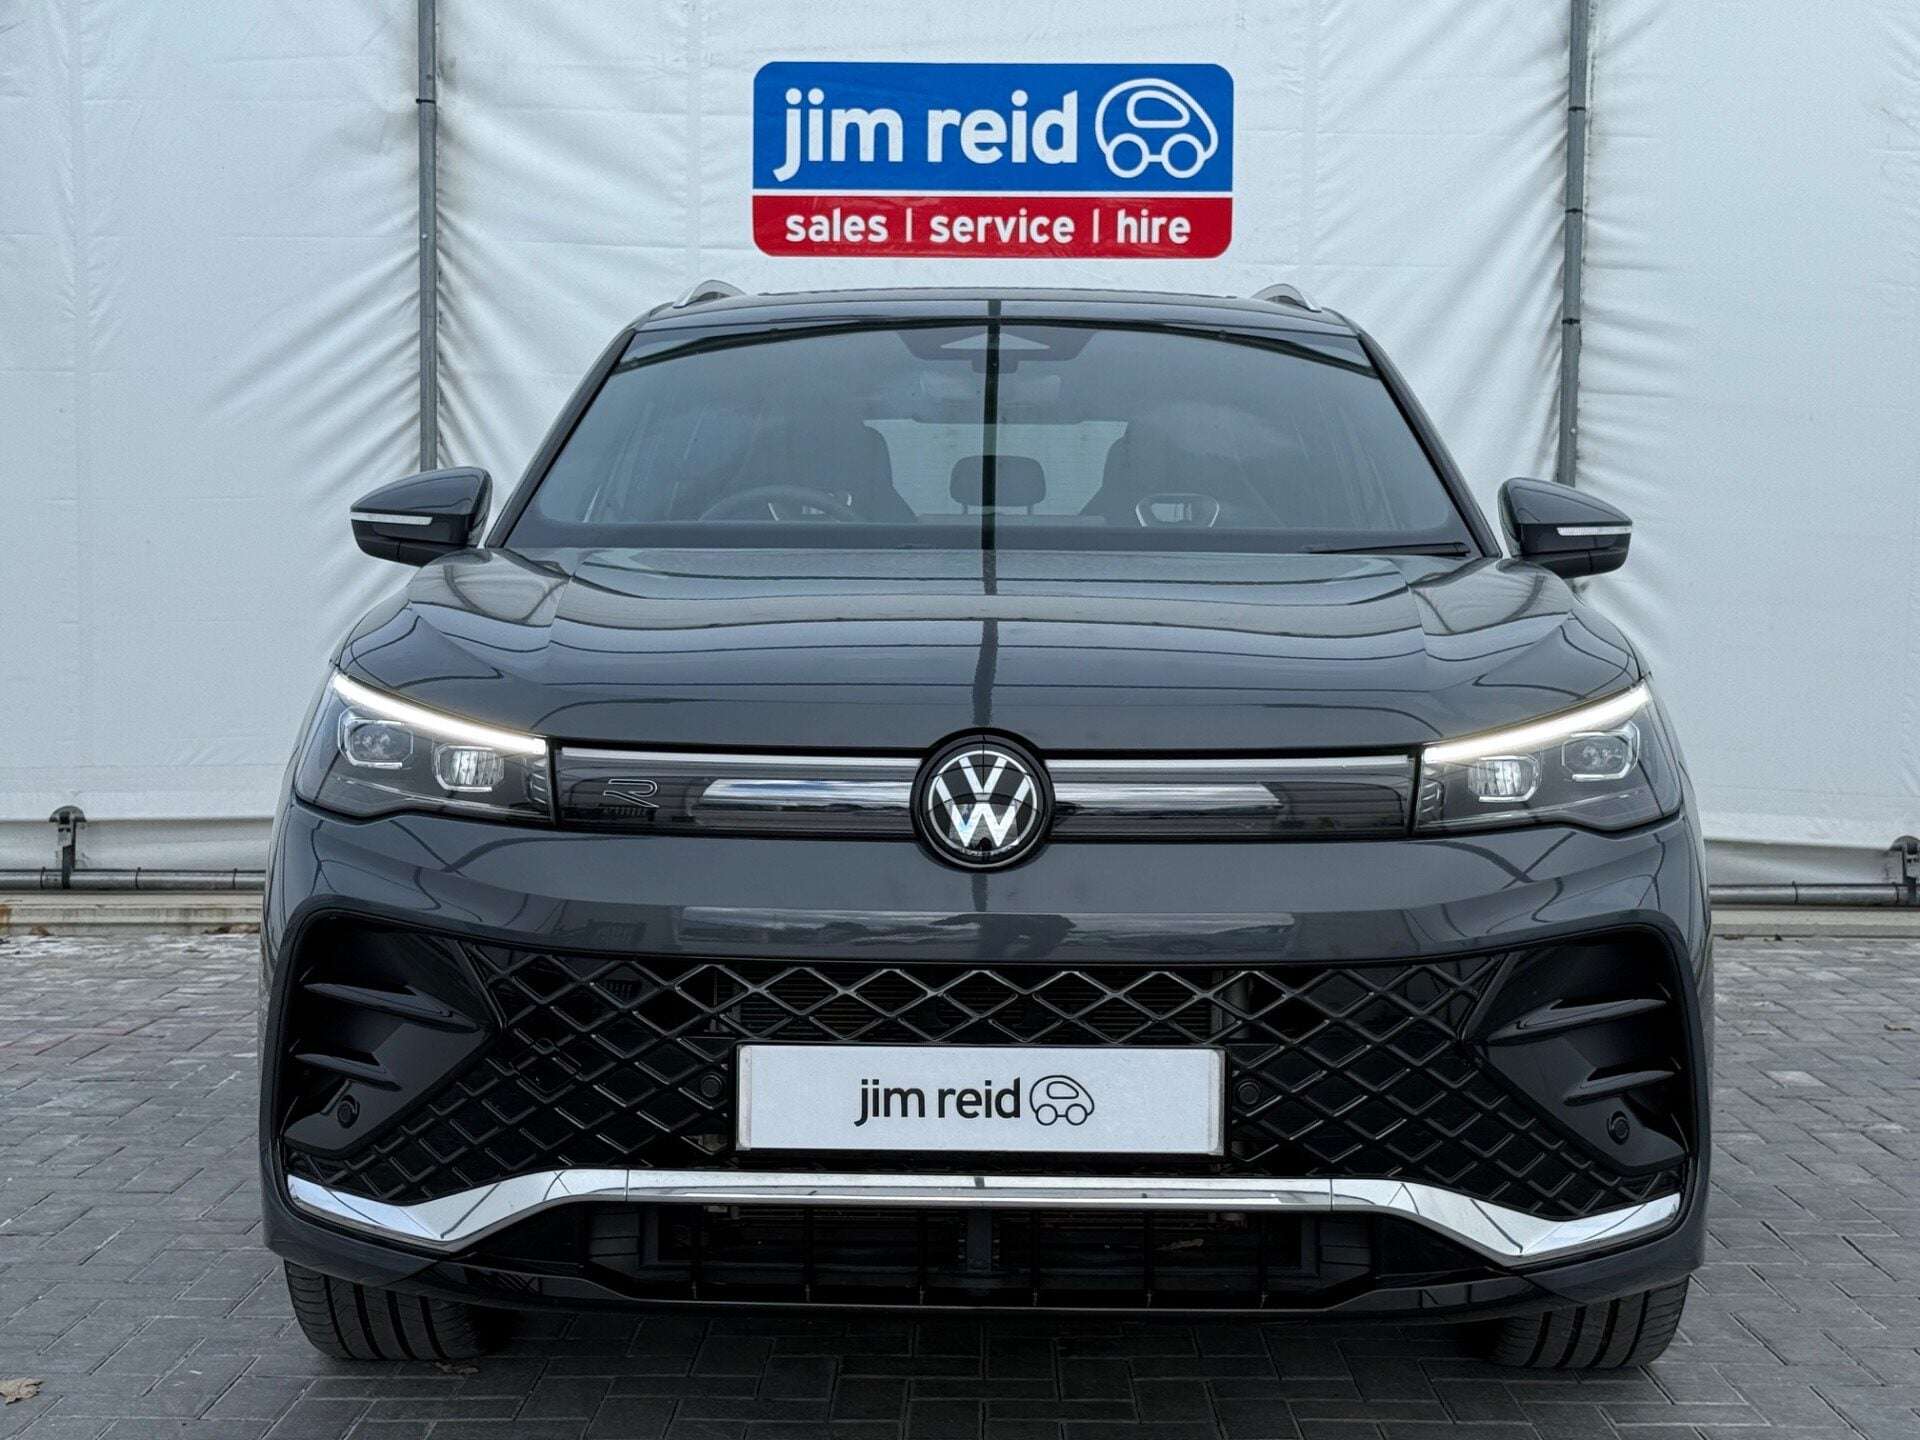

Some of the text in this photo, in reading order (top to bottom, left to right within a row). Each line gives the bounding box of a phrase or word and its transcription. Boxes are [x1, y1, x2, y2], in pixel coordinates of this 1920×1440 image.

[773, 88, 1079, 182] jim reid
[785, 209, 1192, 244] sales service hire
[853, 1077, 1021, 1127] jim reid
